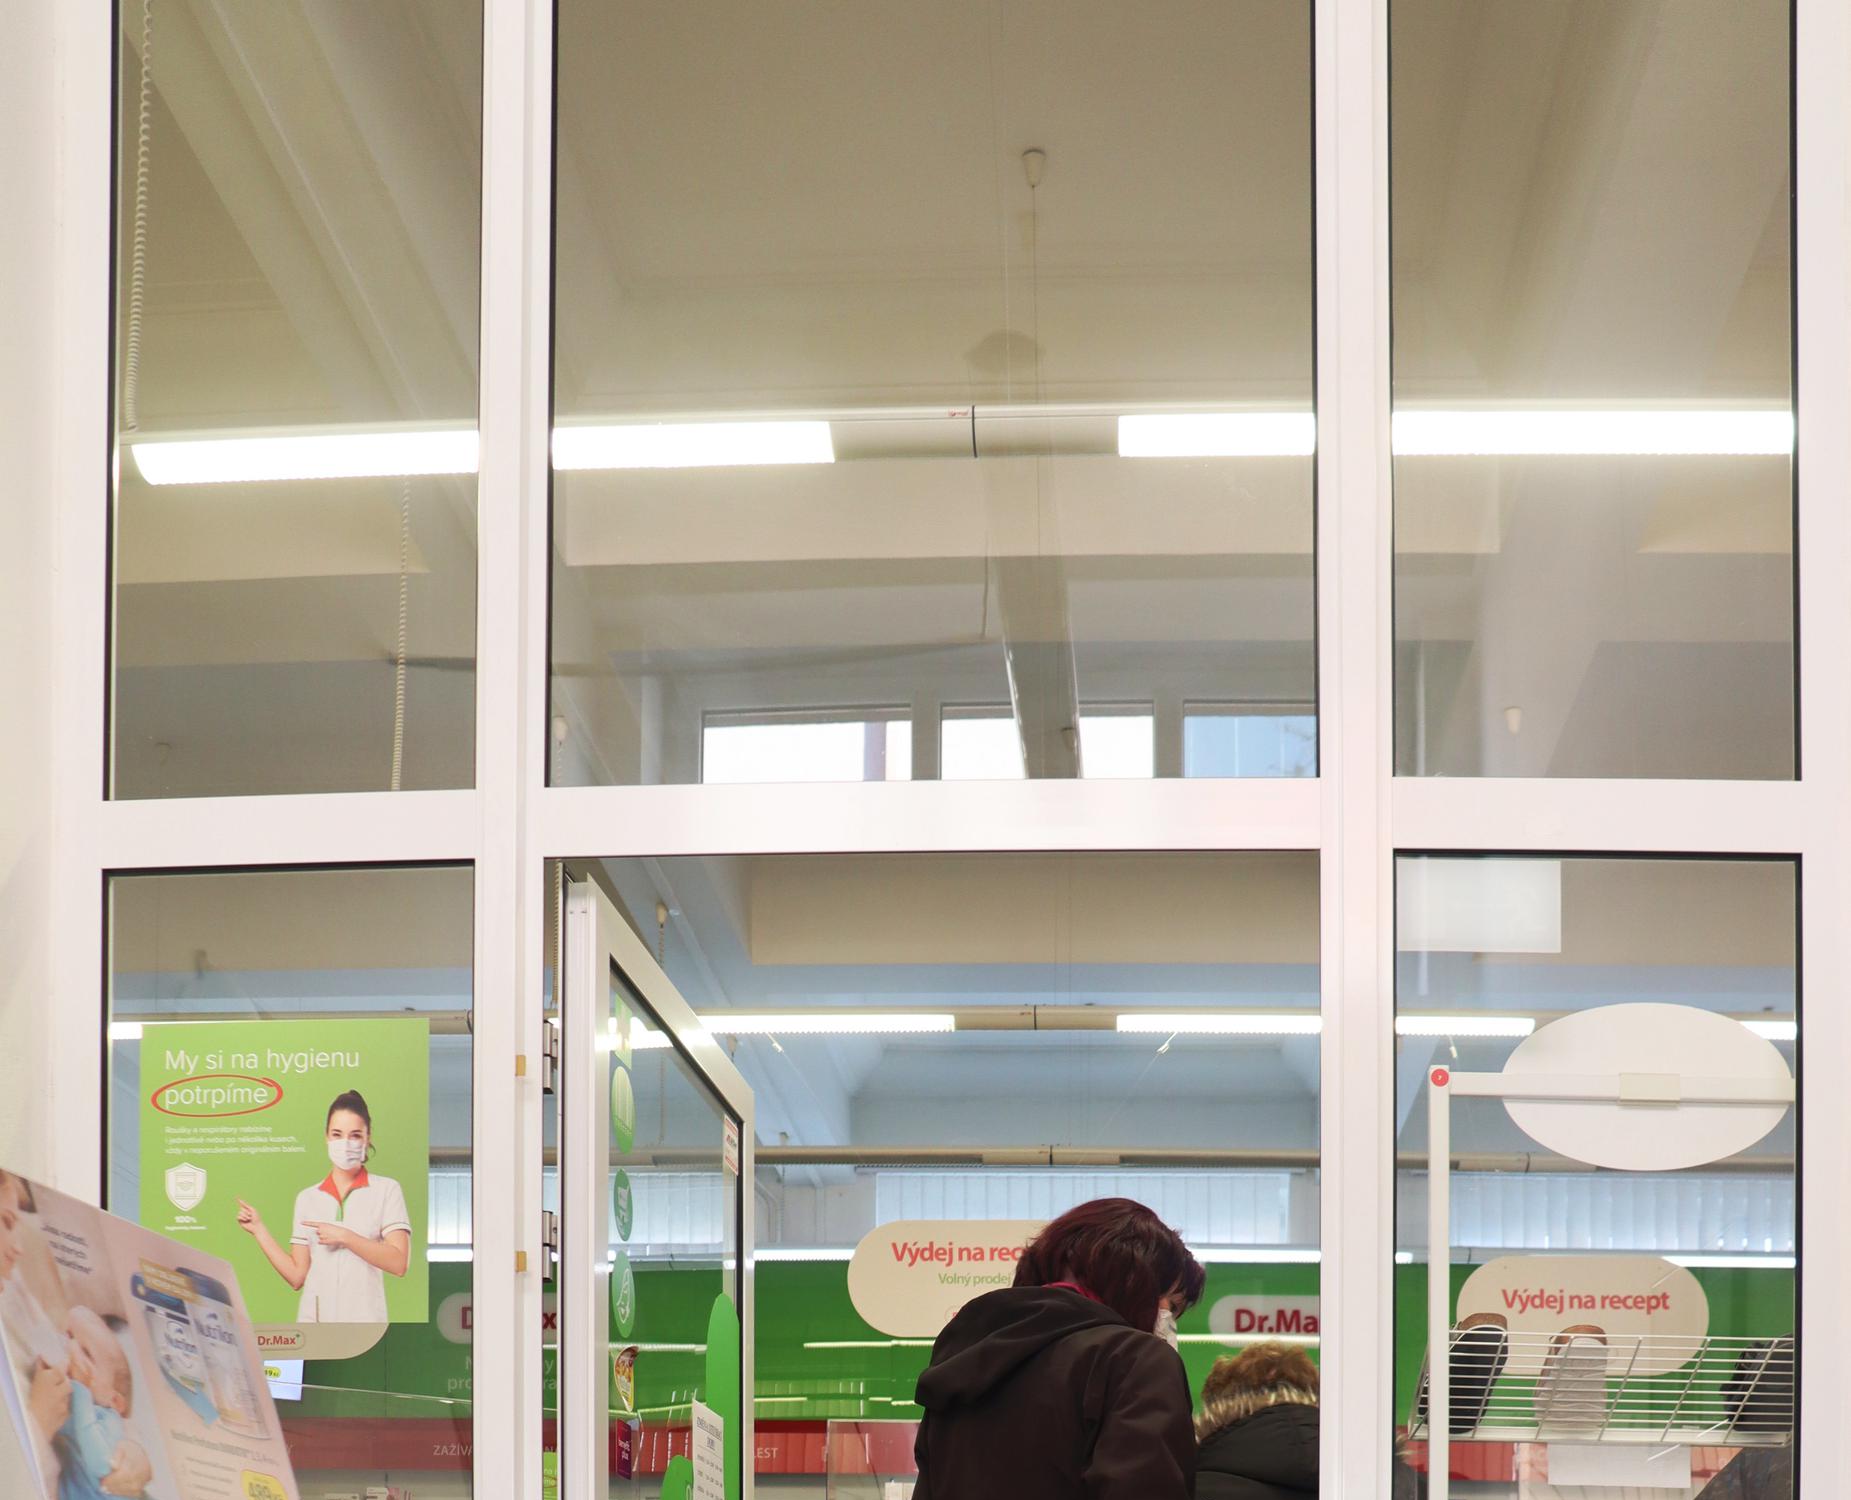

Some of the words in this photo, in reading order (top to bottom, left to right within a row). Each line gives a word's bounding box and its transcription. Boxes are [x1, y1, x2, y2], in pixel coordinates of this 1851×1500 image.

[165, 1050, 199, 1075] My
[206, 1050, 223, 1070] si
[231, 1053, 259, 1069] na
[267, 1048, 360, 1074] hygienu
[165, 1083, 269, 1109] potrpíme
[892, 1241, 953, 1267] Výdej
[958, 1247, 984, 1262] na
[989, 1247, 1024, 1262] rec
[938, 1273, 972, 1287] Volný
[973, 1273, 1011, 1287] prodej
[1502, 1288, 1565, 1314] Výdej
[1569, 1293, 1597, 1309] na
[1600, 1290, 1670, 1315] recept
[1234, 1308, 1320, 1334] Dr.Ma
[257, 1335, 297, 1346] Dr.Max
[754, 1448, 778, 1459] EST
